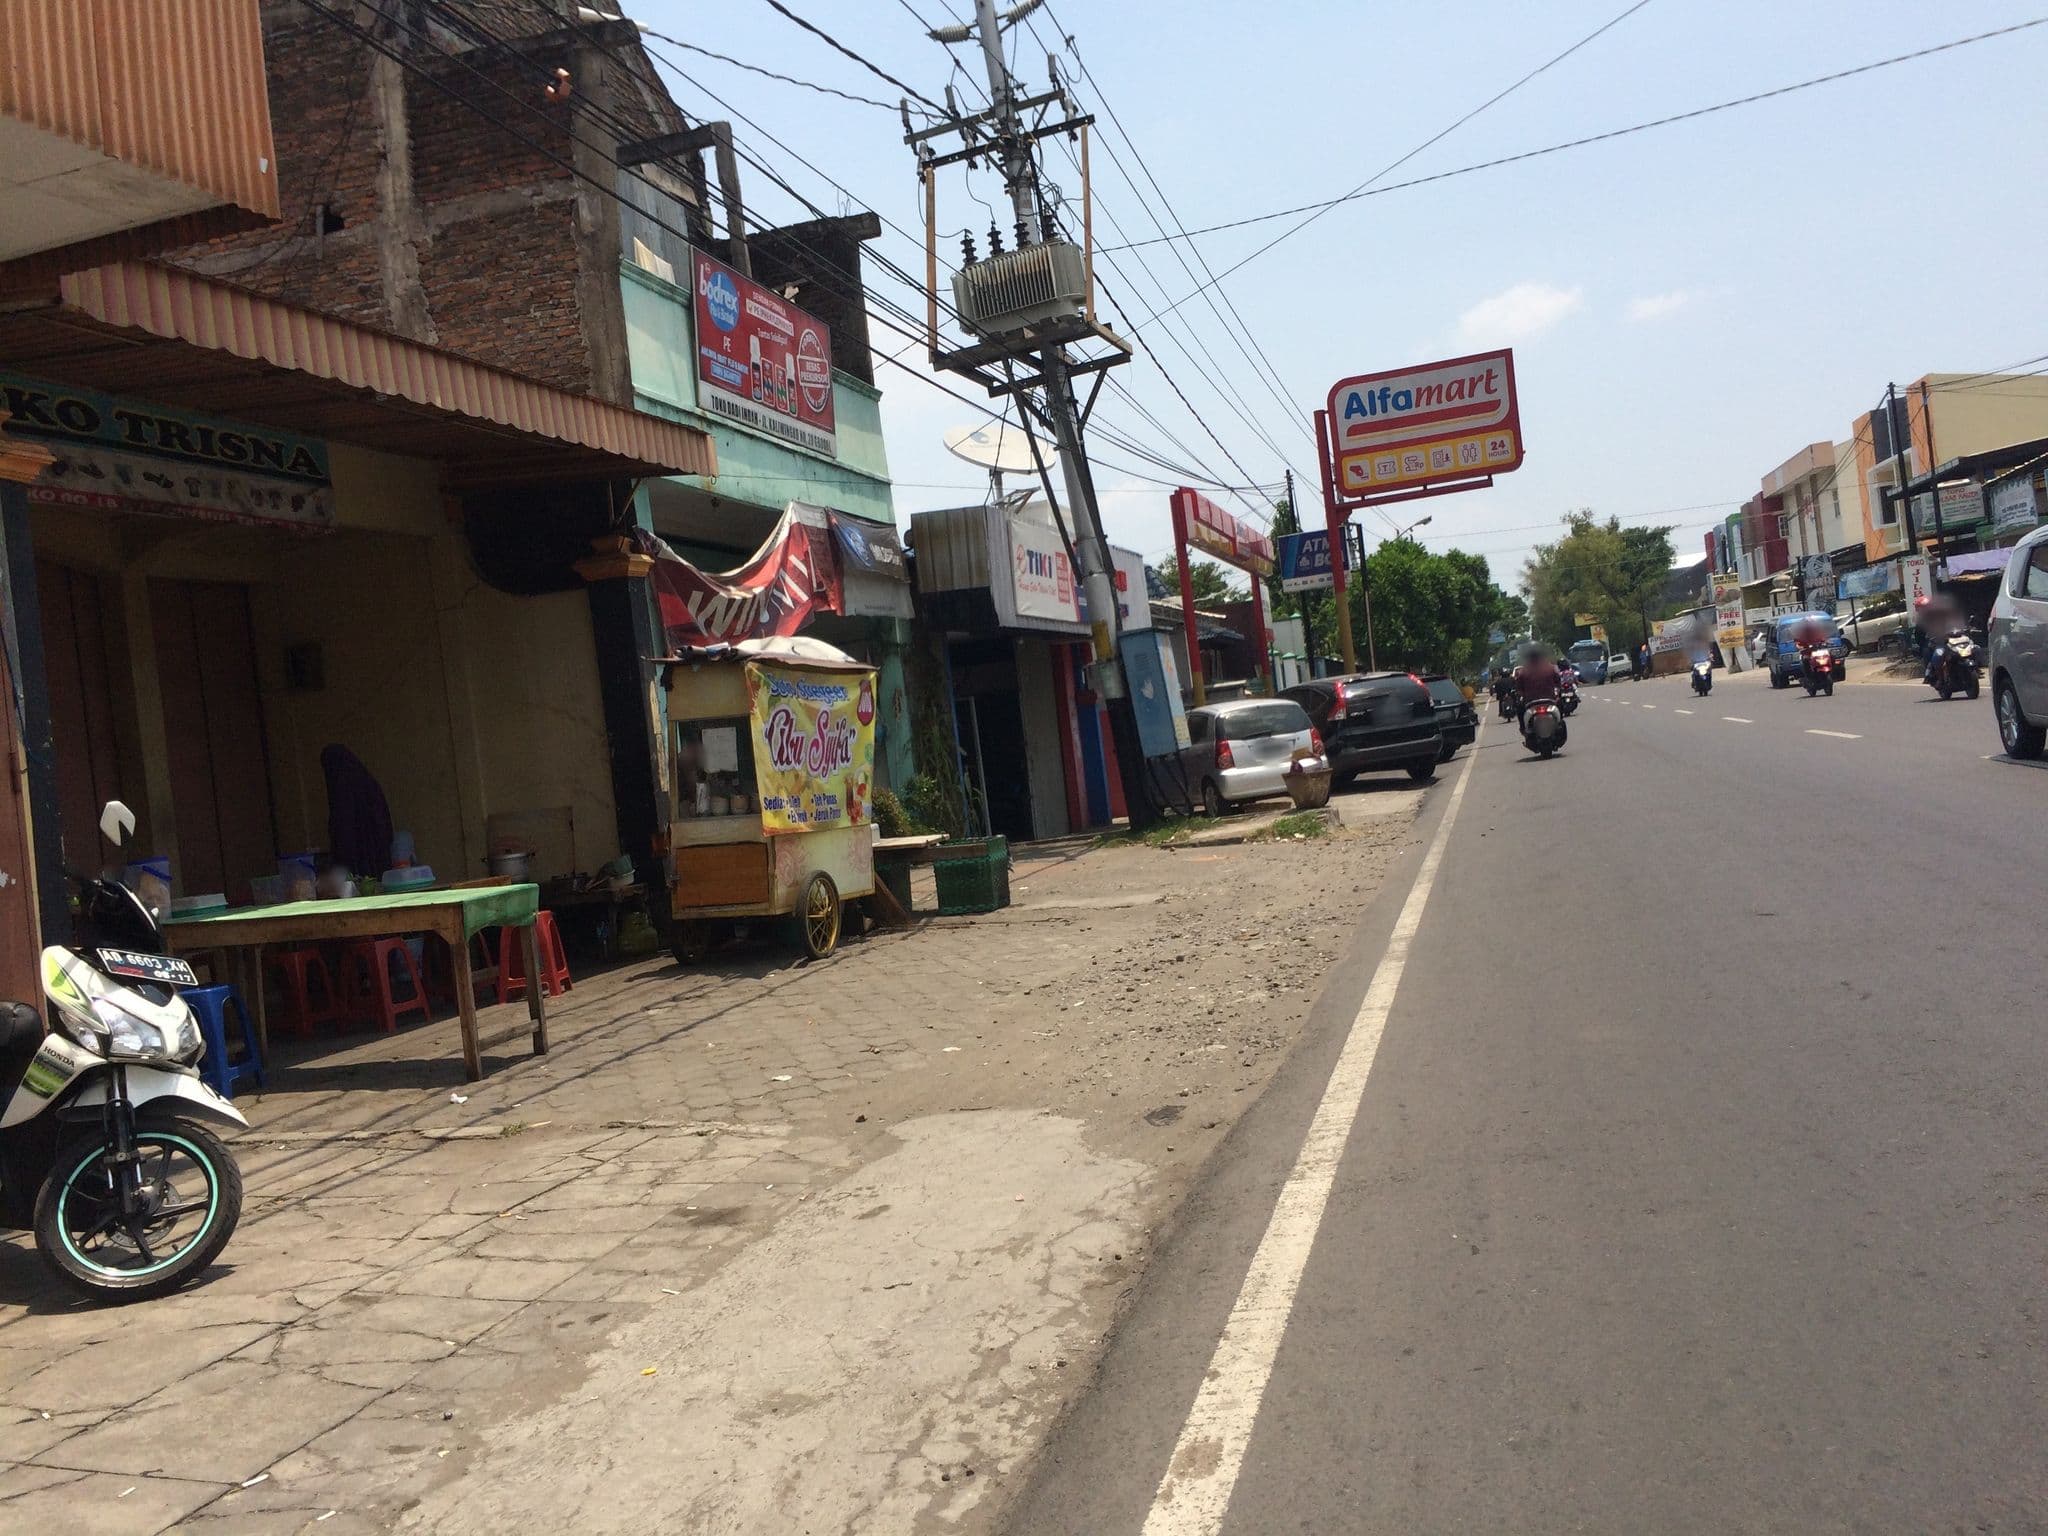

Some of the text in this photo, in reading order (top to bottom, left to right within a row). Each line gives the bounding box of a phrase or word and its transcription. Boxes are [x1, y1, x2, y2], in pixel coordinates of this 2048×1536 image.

[700, 264, 738, 310] bodrex
[1344, 368, 1498, 420] Alfamart
[114, 410, 325, 478] TRISNA
[1491, 440, 1506, 451] 24
[1906, 559, 1925, 567] TOKO
[102, 950, 123, 961] AD
[126, 954, 162, 969] 6603
[43, 1046, 75, 1068] HONDA
